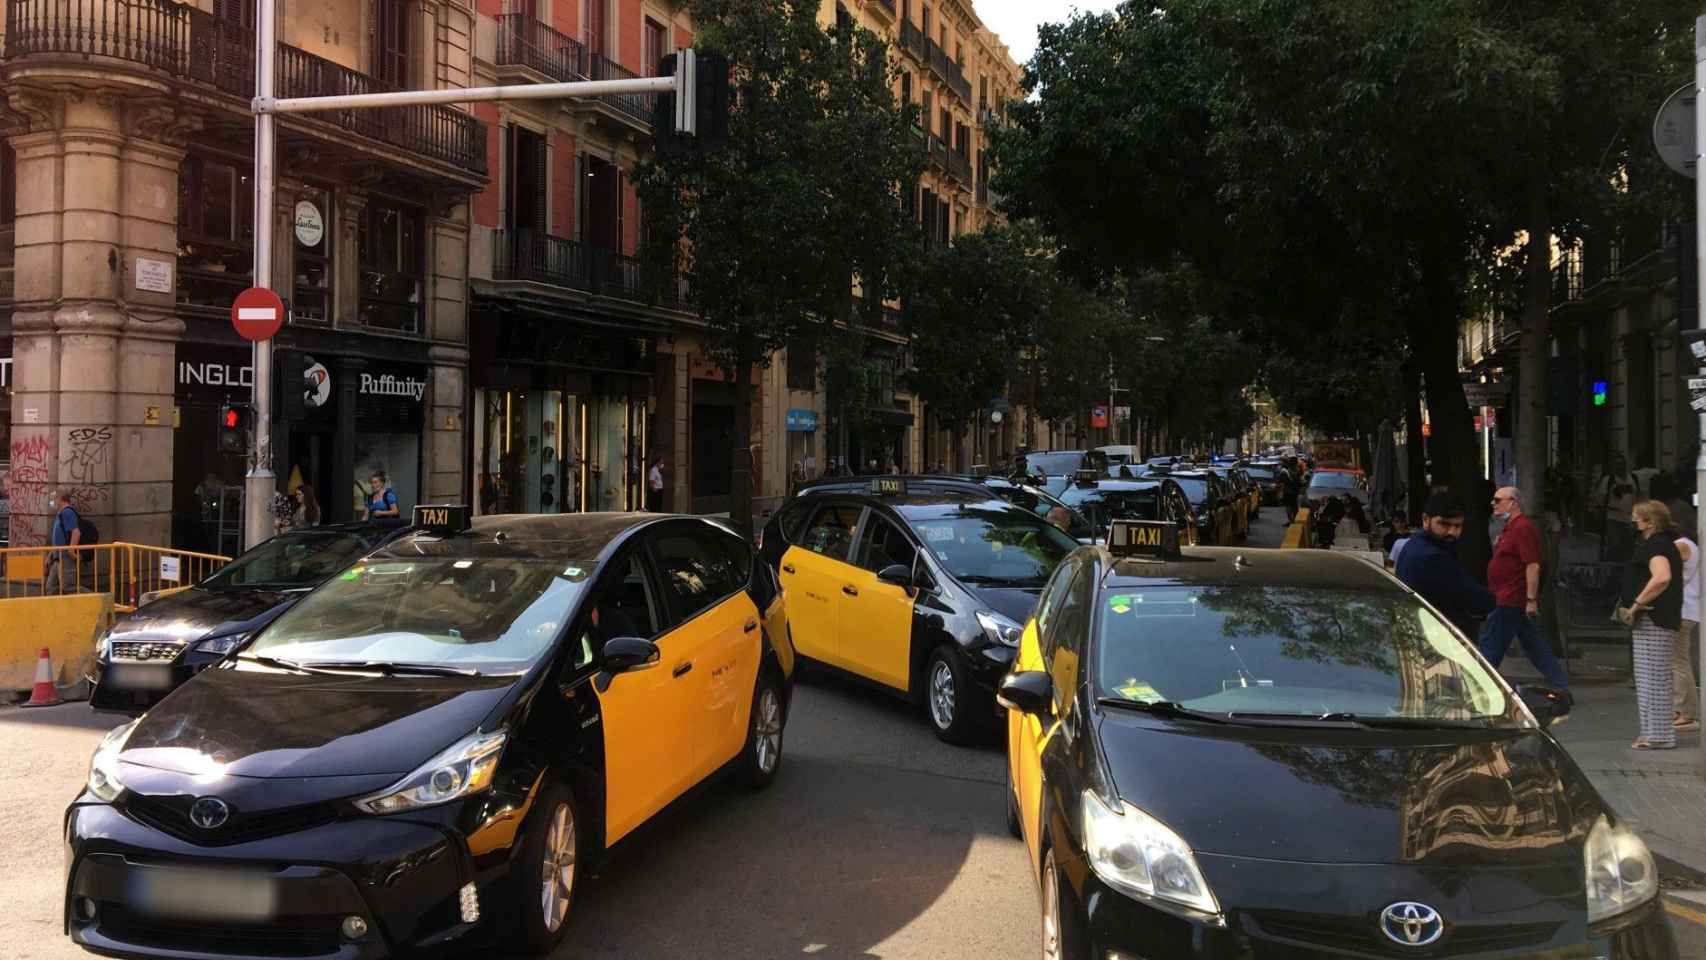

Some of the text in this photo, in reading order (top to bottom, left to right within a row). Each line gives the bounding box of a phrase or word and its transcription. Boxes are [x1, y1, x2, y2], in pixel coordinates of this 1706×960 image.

[360, 373, 426, 402] Puffinity
[881, 480, 897, 491] TAXI
[421, 509, 448, 525] TAXI
[1129, 527, 1161, 545] TAXI
